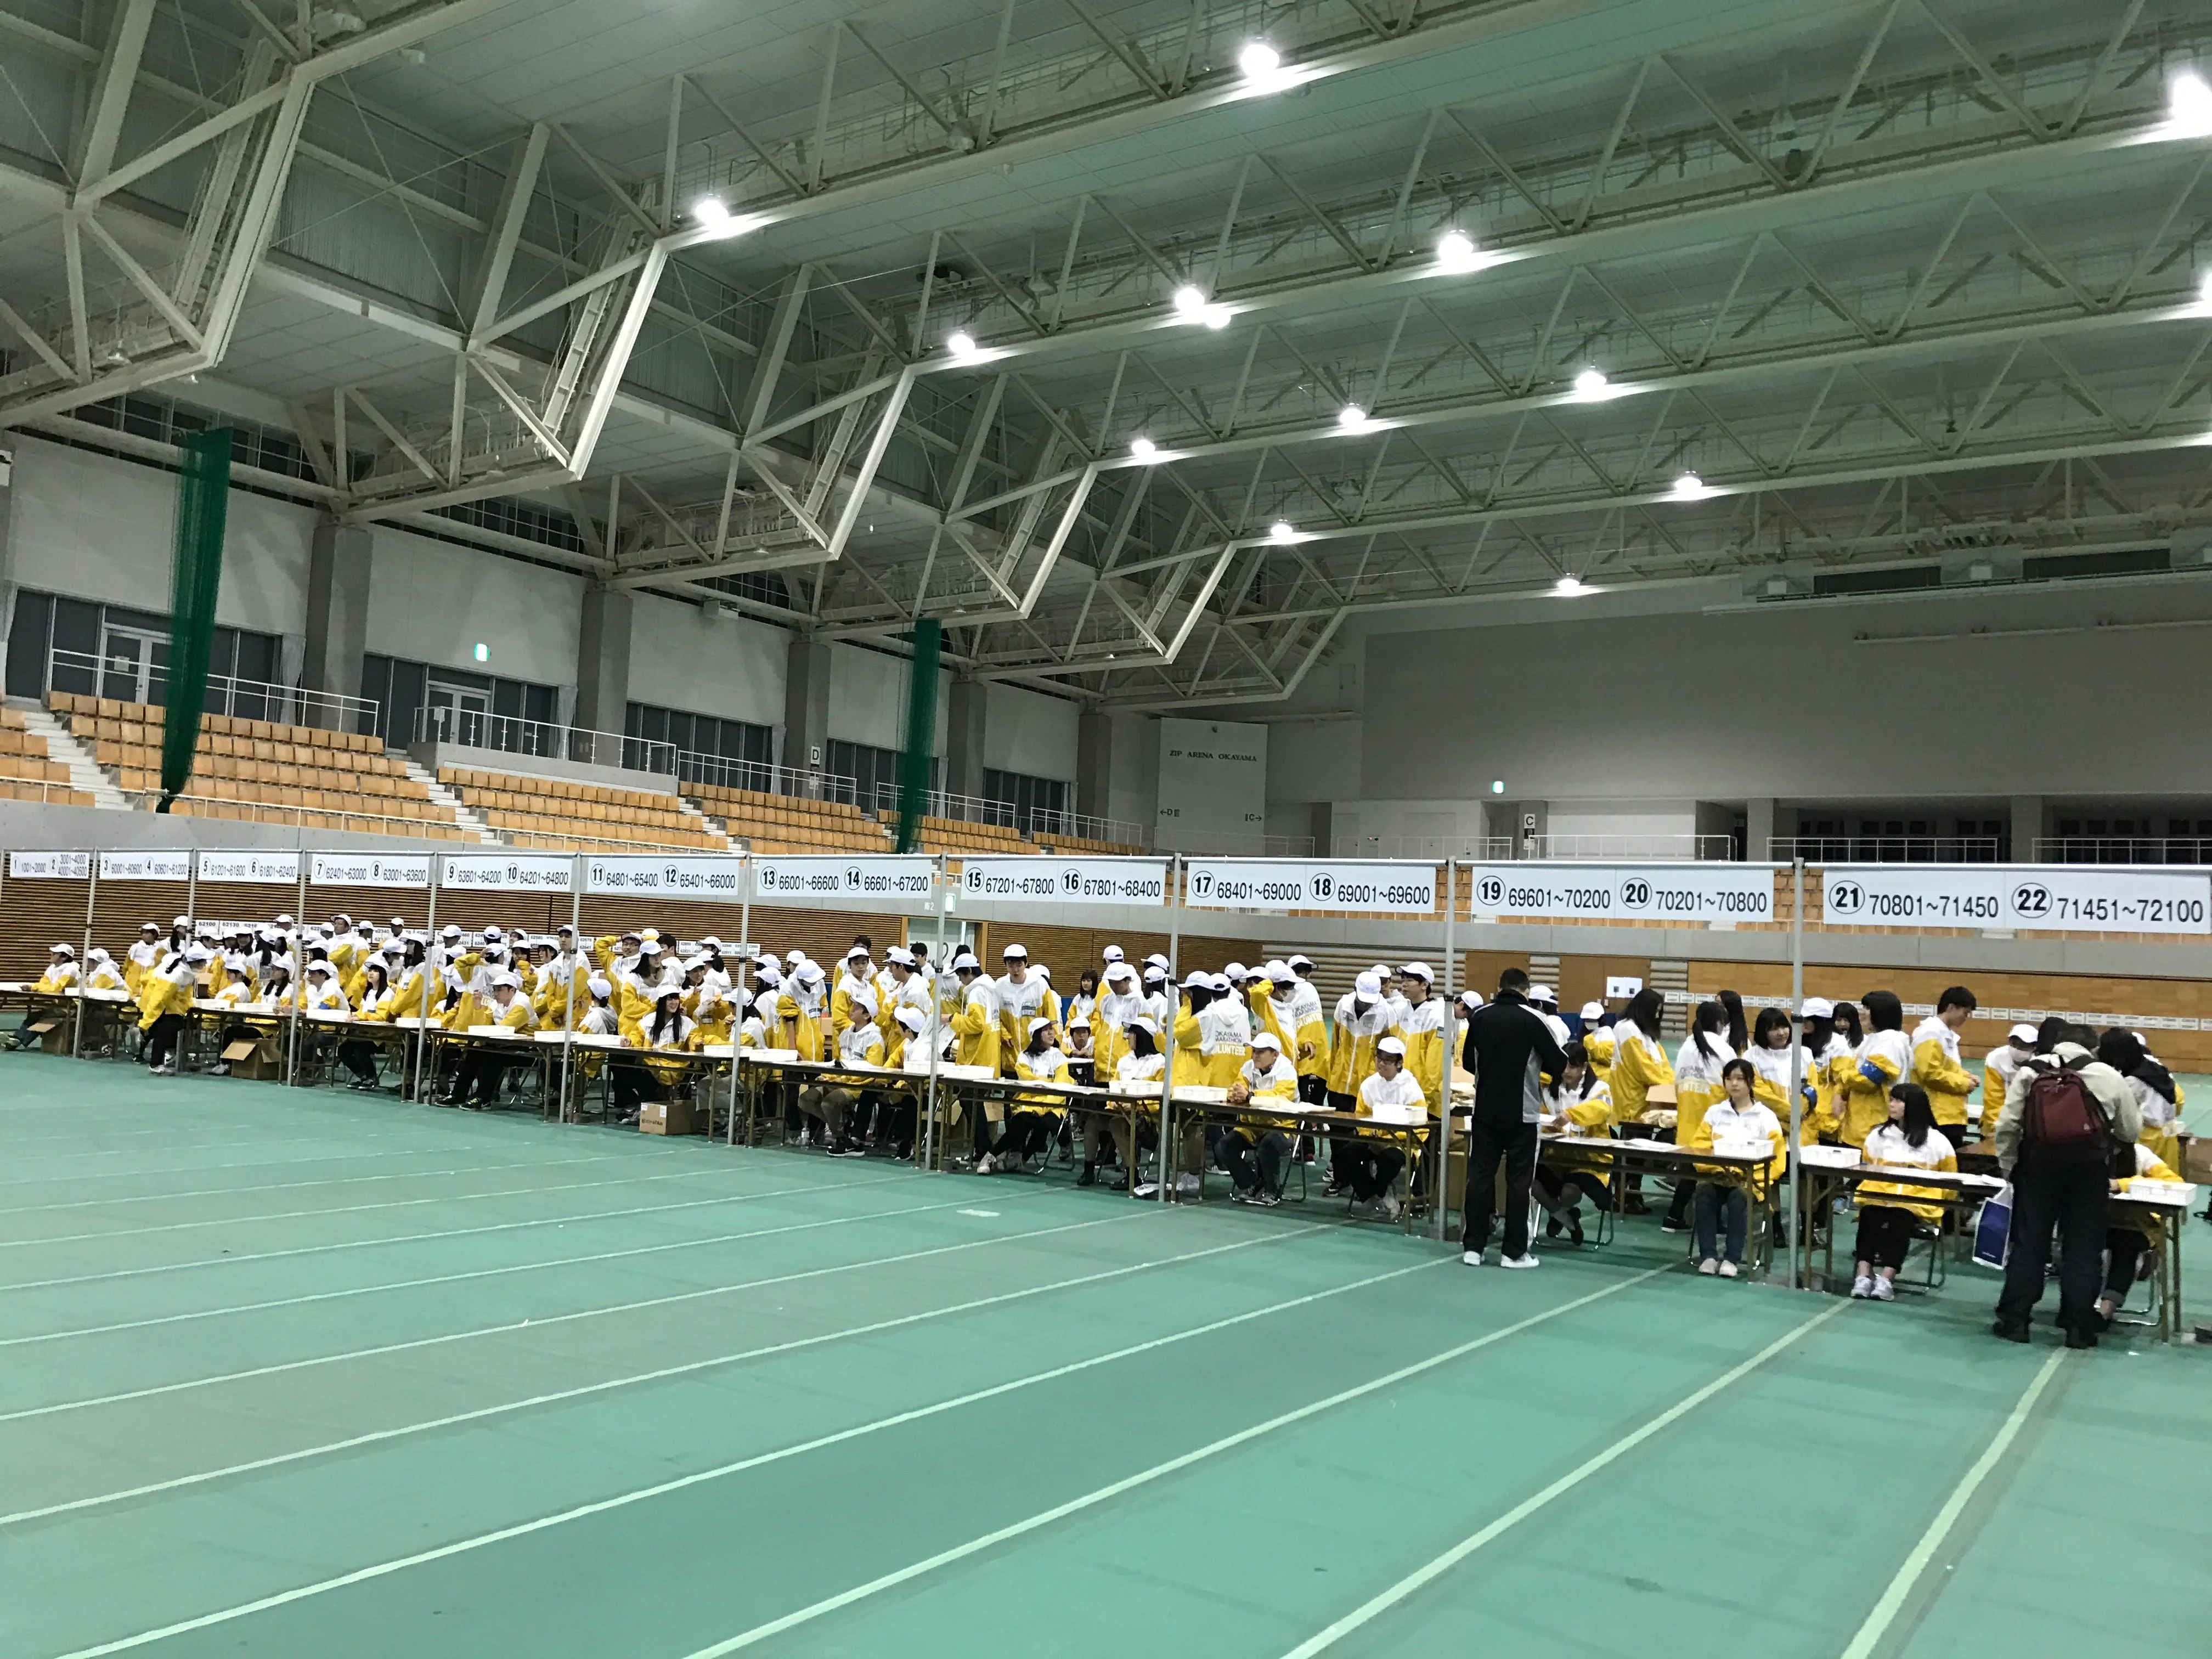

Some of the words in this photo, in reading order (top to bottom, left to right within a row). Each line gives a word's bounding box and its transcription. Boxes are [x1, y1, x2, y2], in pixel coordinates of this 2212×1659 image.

[812, 749, 819, 760] D
[1187, 751, 1214, 759] ARENA
[1218, 753, 1257, 761] OKAYAMA
[1526, 816, 1534, 826] C
[326, 868, 366, 880] 62401~63000
[383, 869, 426, 882] 63001~63600
[459, 871, 501, 883] 63601~64200
[520, 871, 568, 885] 64201~64800
[607, 873, 658, 887] 64801~65400
[680, 874, 735, 888] 65401~66000
[780, 876, 838, 890] 66001~66600
[865, 876, 928, 891] 66601~67200
[986, 878, 1054, 894] 67201~67800
[1085, 879, 1160, 897] 67801~68400
[1217, 882, 1301, 900] 68401~69000
[1338, 885, 1430, 904] 69001~69600
[1509, 888, 1610, 909] 69601~70200
[1656, 891, 1767, 912] 70201~70800
[1870, 895, 1998, 917] 70801~71450
[2057, 898, 2203, 922] 71451~72100
